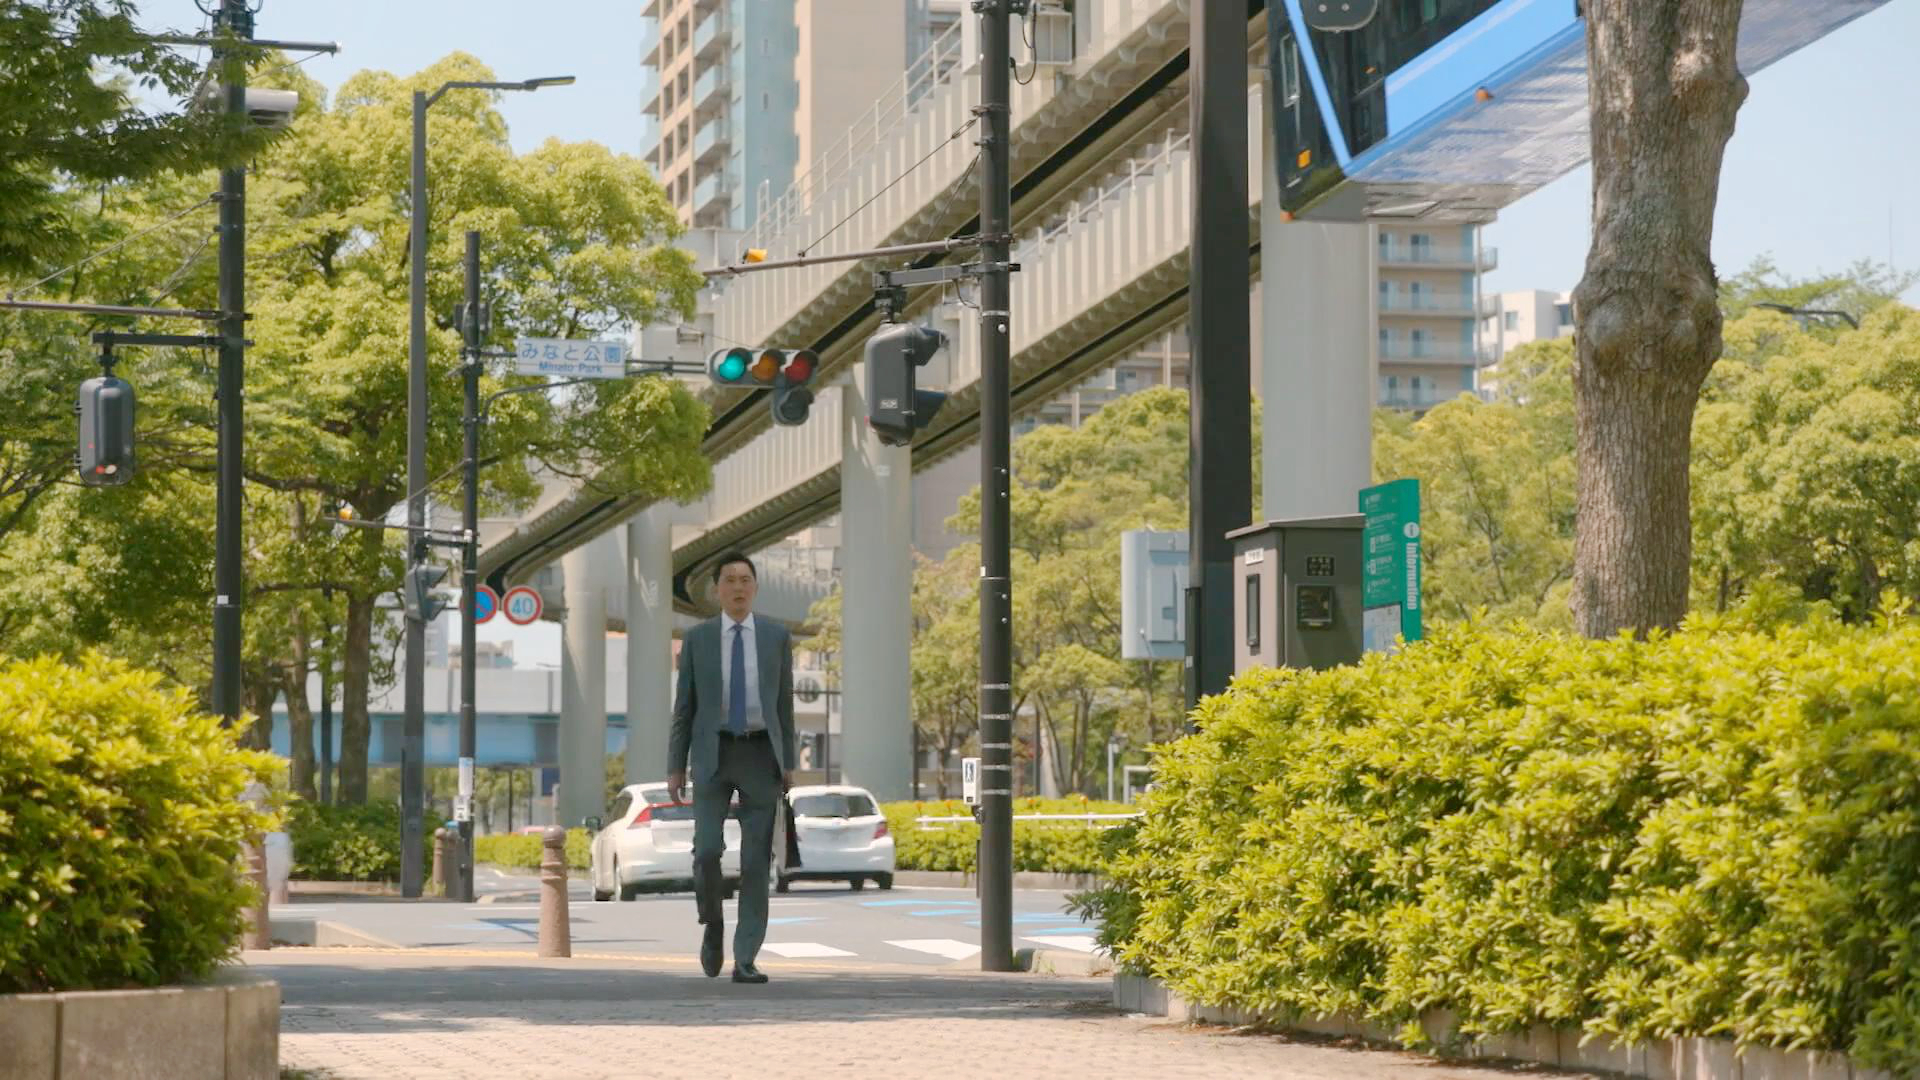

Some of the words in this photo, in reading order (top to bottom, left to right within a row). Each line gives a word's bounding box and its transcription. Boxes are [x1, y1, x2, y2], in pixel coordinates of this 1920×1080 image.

[522, 343, 621, 363] みなと公園
[540, 361, 576, 372] Minato
[579, 363, 603, 374] Park
[1406, 542, 1418, 610] Information
[512, 597, 533, 614] 40
